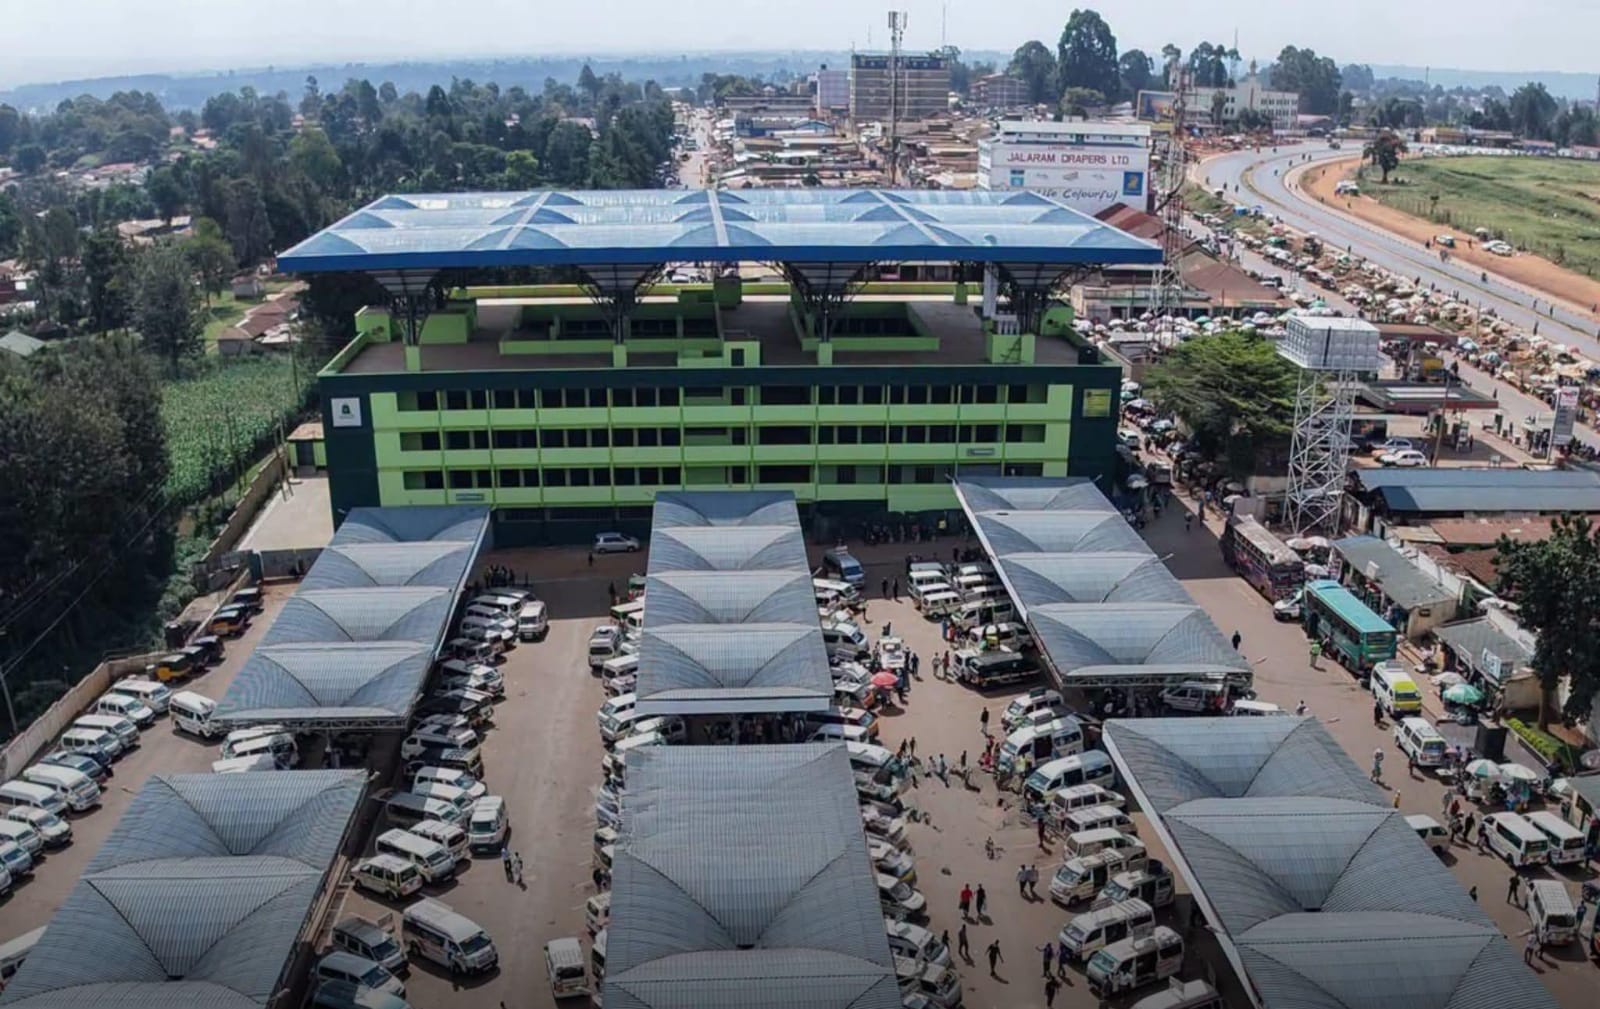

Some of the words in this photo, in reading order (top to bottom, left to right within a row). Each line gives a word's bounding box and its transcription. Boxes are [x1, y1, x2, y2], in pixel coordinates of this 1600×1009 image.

[1007, 152, 1055, 163] JALARAM
[1061, 154, 1107, 164] DRAPERS
[1112, 155, 1130, 165] LTD
